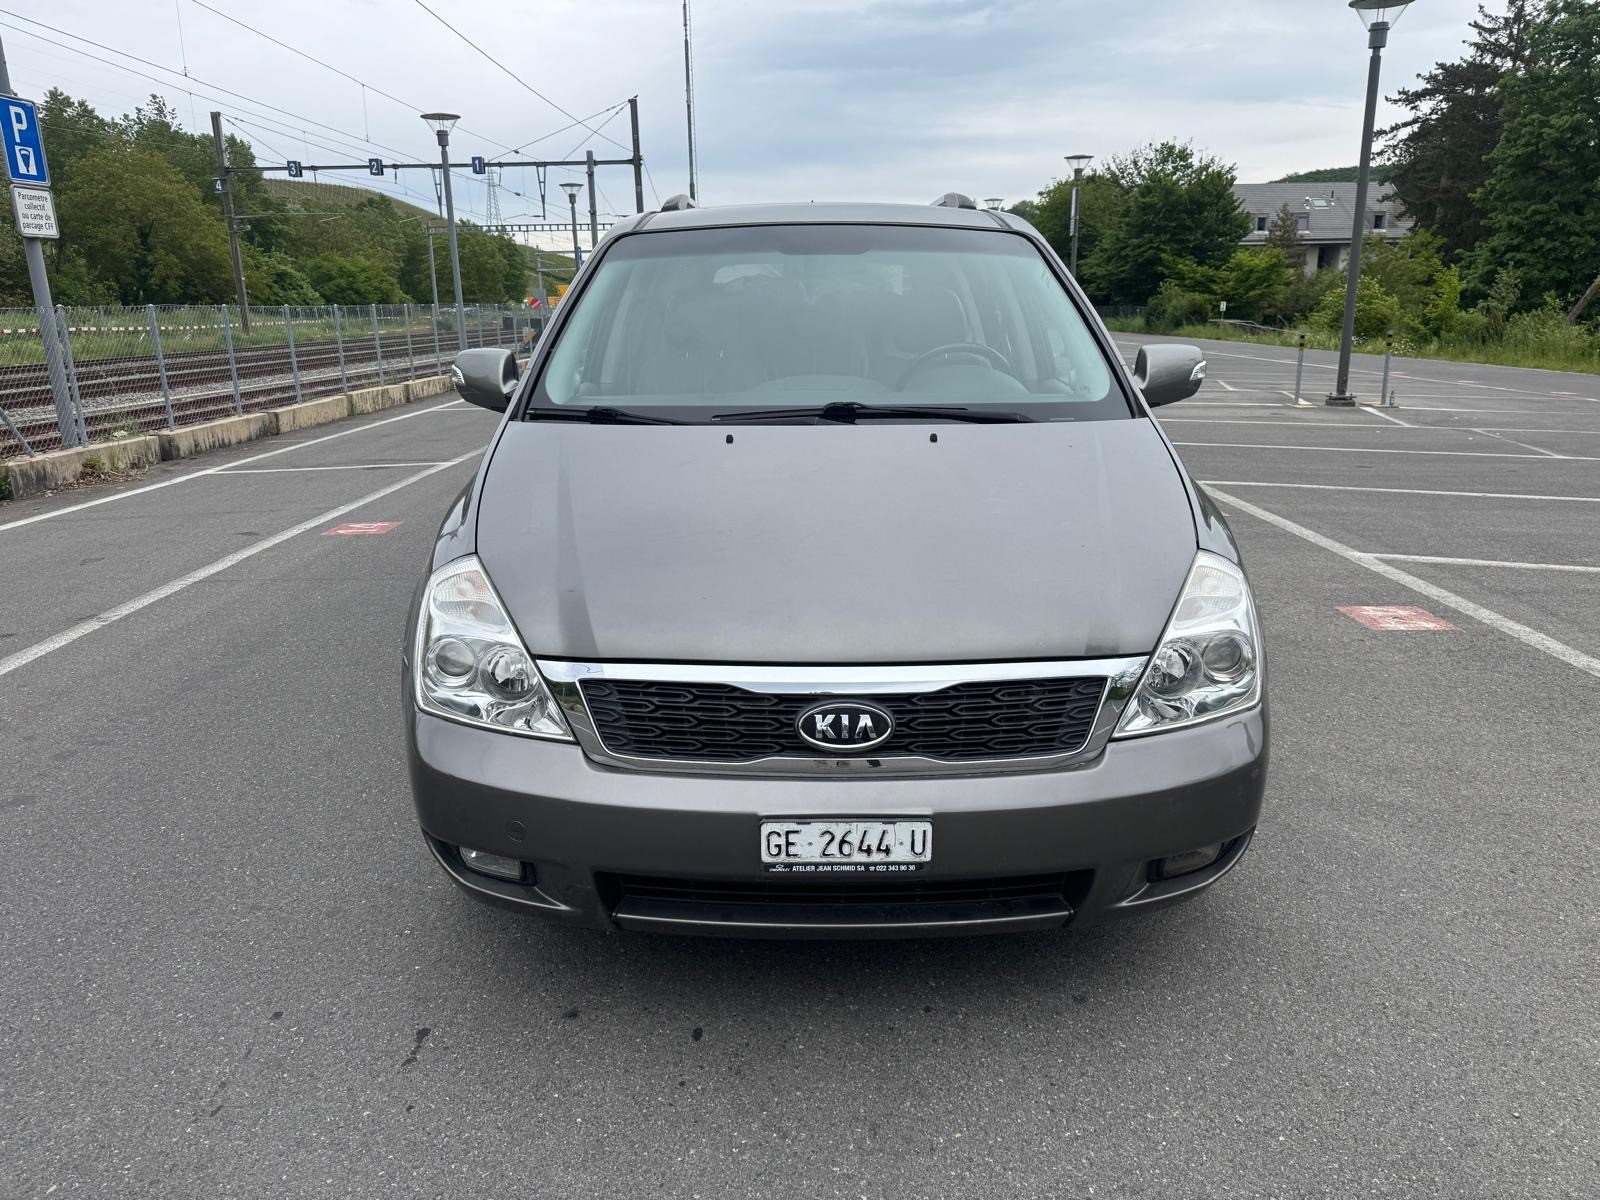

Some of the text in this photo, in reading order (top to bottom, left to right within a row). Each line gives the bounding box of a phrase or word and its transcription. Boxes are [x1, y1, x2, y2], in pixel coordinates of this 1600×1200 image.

[9, 105, 28, 143] P
[289, 163, 296, 175] 3
[371, 161, 378, 173] 2
[474, 160, 480, 171] 1
[216, 180, 222, 191] 4
[45, 213, 52, 221] de
[22, 222, 54, 231] parcage CFF
[813, 713, 878, 739] KIA
[766, 829, 927, 858] GE 2644 U
[792, 864, 816, 872] ATELIER
[816, 864, 832, 872] JEAN
[832, 864, 856, 872] SCHMID
[857, 864, 866, 872] SA
[876, 864, 887, 872] 022
[888, 863, 899, 871] 343
[908, 863, 916, 871] 30
